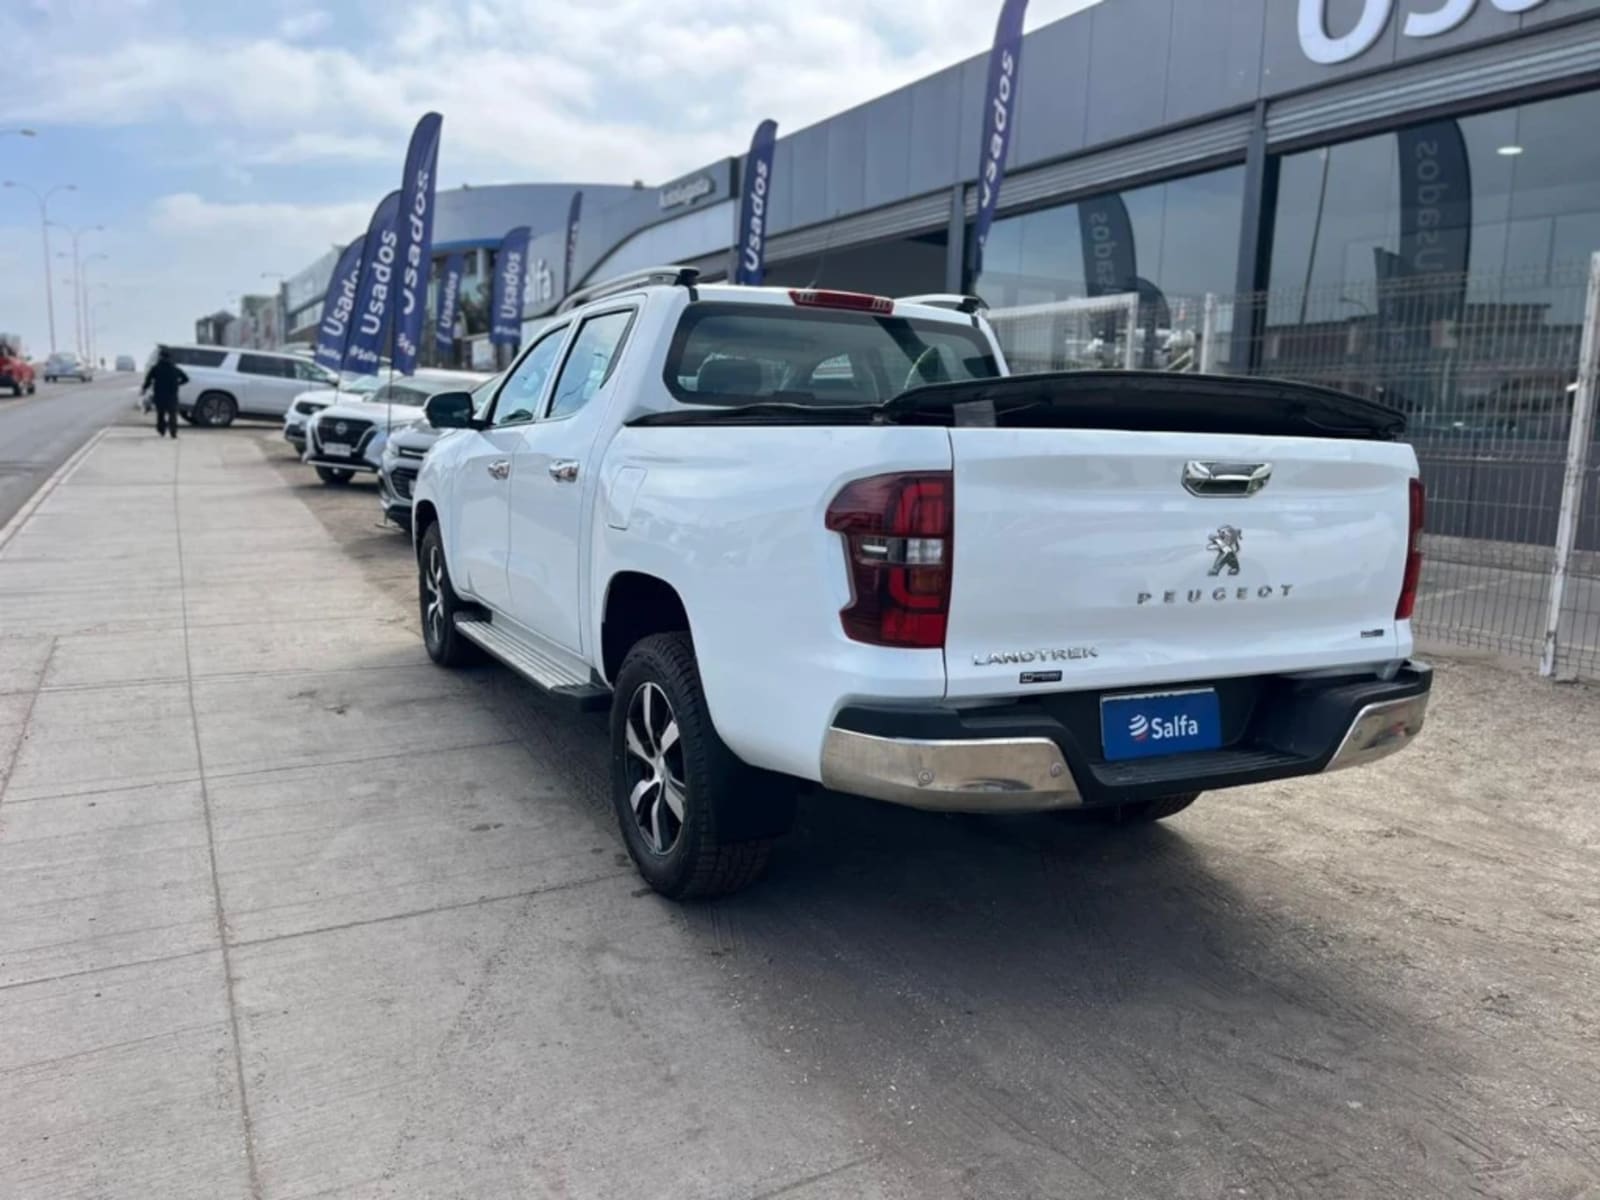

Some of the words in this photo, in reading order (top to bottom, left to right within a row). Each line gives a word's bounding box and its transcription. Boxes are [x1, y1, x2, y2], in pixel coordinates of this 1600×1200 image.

[745, 159, 768, 271] Usados
[361, 229, 397, 336] Usados
[502, 252, 521, 319] Usados
[1136, 584, 1294, 604] PEUGEOT
[972, 647, 1098, 666] LANDTREK
[1151, 715, 1199, 740] Salfa
